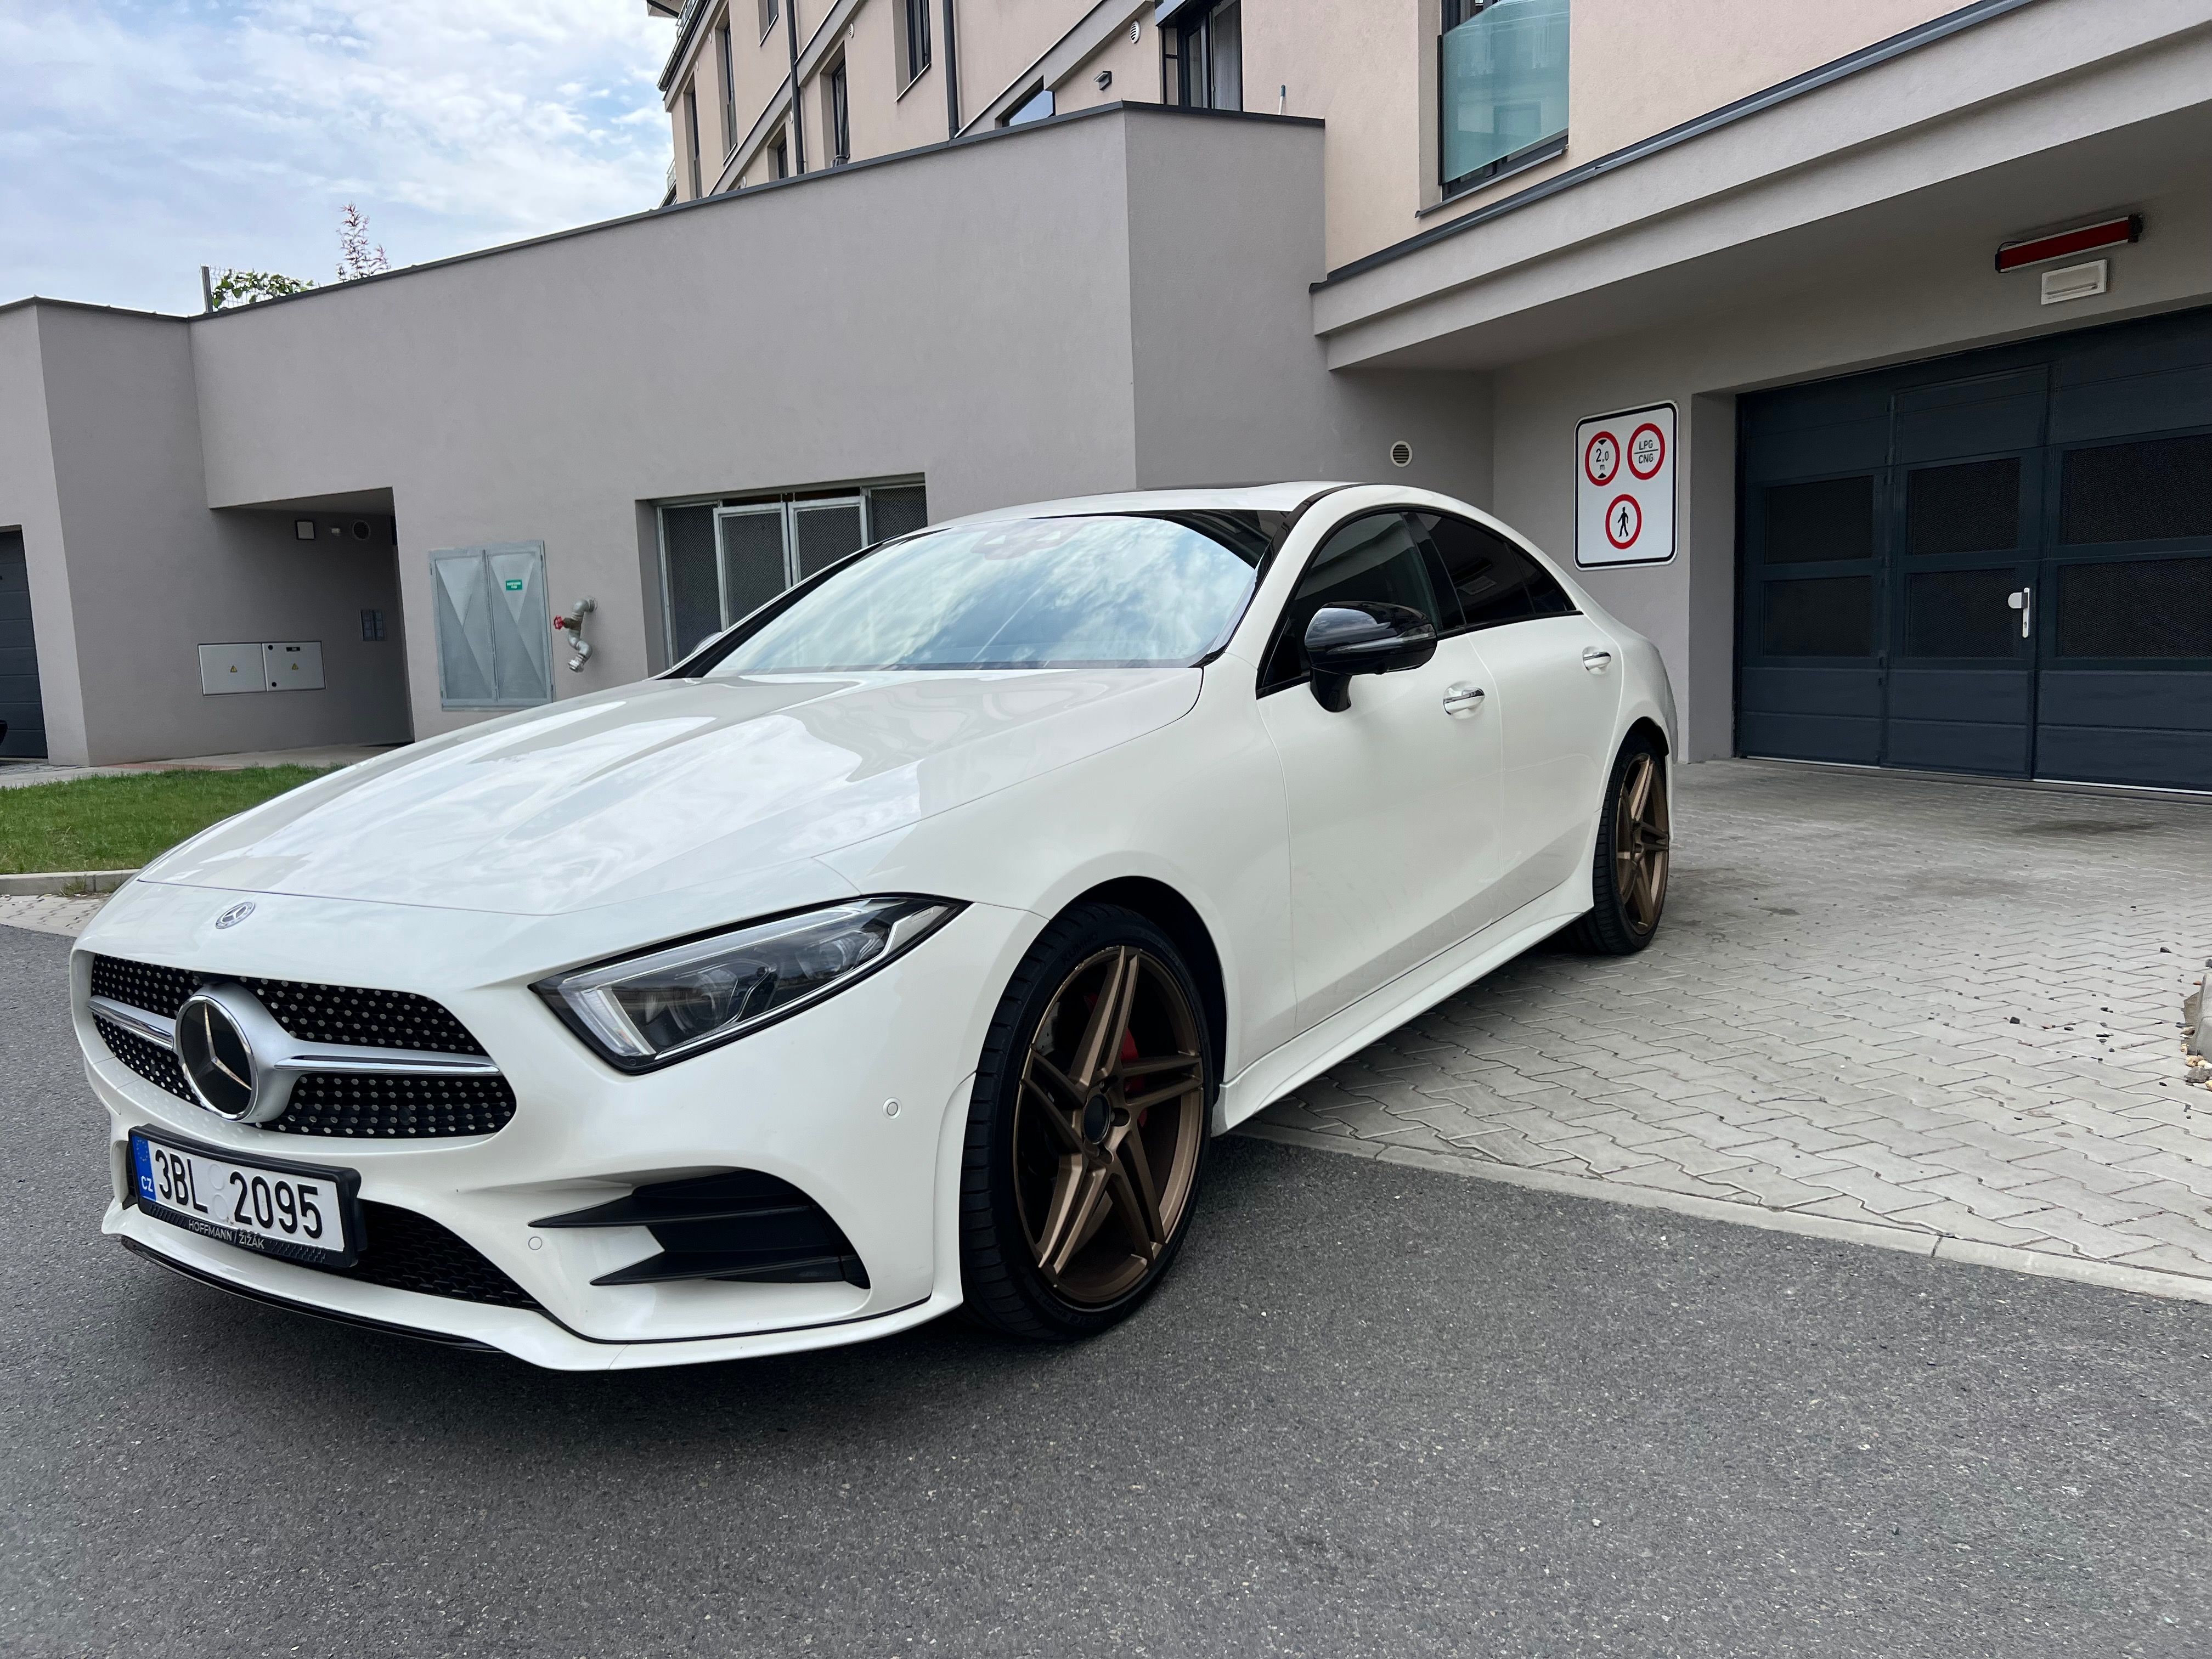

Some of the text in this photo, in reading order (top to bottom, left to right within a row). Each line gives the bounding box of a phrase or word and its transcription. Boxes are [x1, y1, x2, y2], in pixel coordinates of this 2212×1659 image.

[1639, 439, 1654, 450] LPG
[1638, 453, 1654, 464] CNG
[141, 1175, 154, 1193] CZ
[155, 1149, 323, 1239] 3BL 2095
[188, 1219, 233, 1242] HOFFMANN
[239, 1231, 265, 1250] ŽIŽÁK
